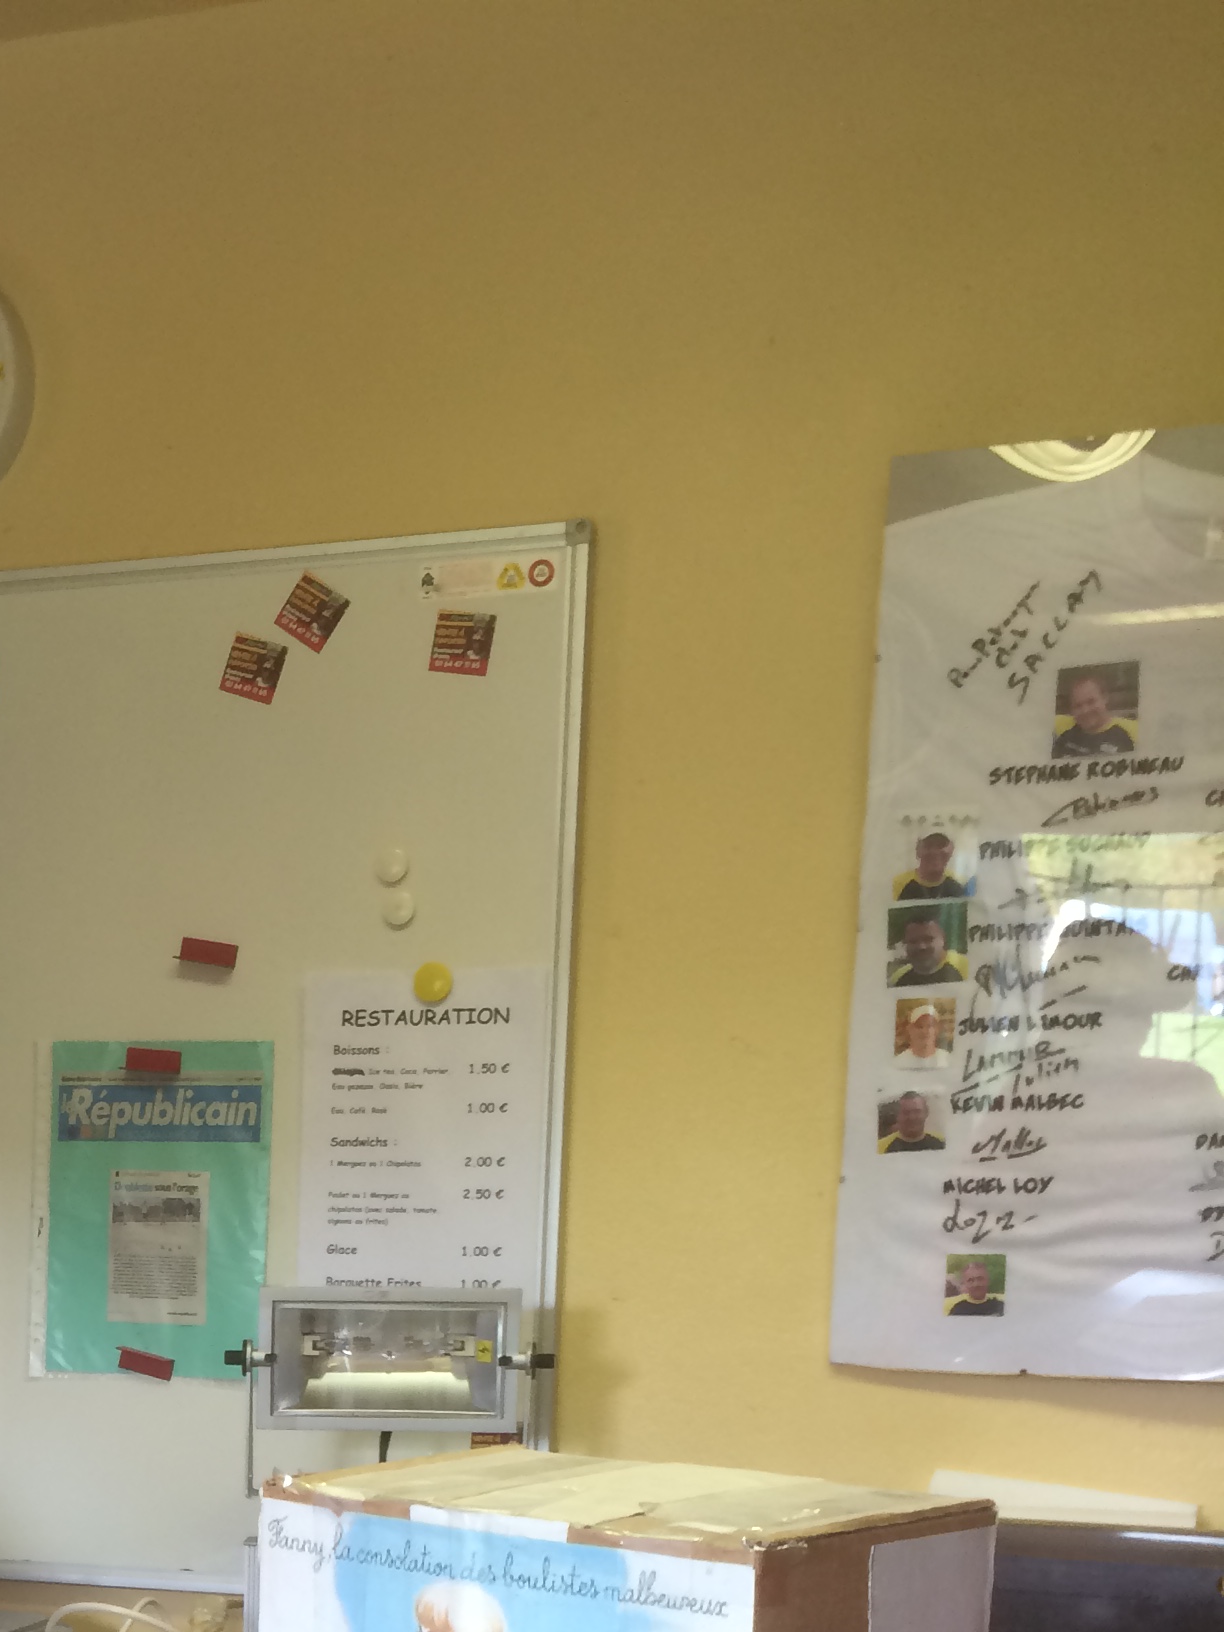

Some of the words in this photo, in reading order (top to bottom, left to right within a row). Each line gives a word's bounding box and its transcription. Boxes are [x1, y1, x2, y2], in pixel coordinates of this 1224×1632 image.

[988, 762, 1081, 786] STEPHANE
[341, 1007, 511, 1028] RESTAURATION
[333, 1045, 380, 1056] Boissons
[468, 1063, 497, 1075] 1.50
[500, 1063, 511, 1074] €
[467, 1102, 495, 1114] 1.00
[498, 1102, 509, 1113] €
[950, 1094, 1005, 1115] KEVIN
[1010, 1092, 1085, 1113] MALBEC
[68, 1088, 258, 1139] Républicain
[330, 1136, 389, 1148] Sandwichs
[464, 1156, 493, 1168] 2.00
[496, 1156, 506, 1167] €
[943, 1177, 1007, 1195] MICHEL
[1013, 1175, 1055, 1195] LOY
[462, 1188, 492, 1200] 2.50
[495, 1188, 505, 1199] €
[326, 1244, 358, 1255] Glace
[461, 1245, 489, 1257] 1.00
[492, 1246, 503, 1257] €
[267, 1516, 332, 1573] Fanny,
[332, 1521, 354, 1563] la
[356, 1539, 455, 1580] consolation
[459, 1551, 497, 1584] des
[502, 1551, 601, 1598] boulistes
